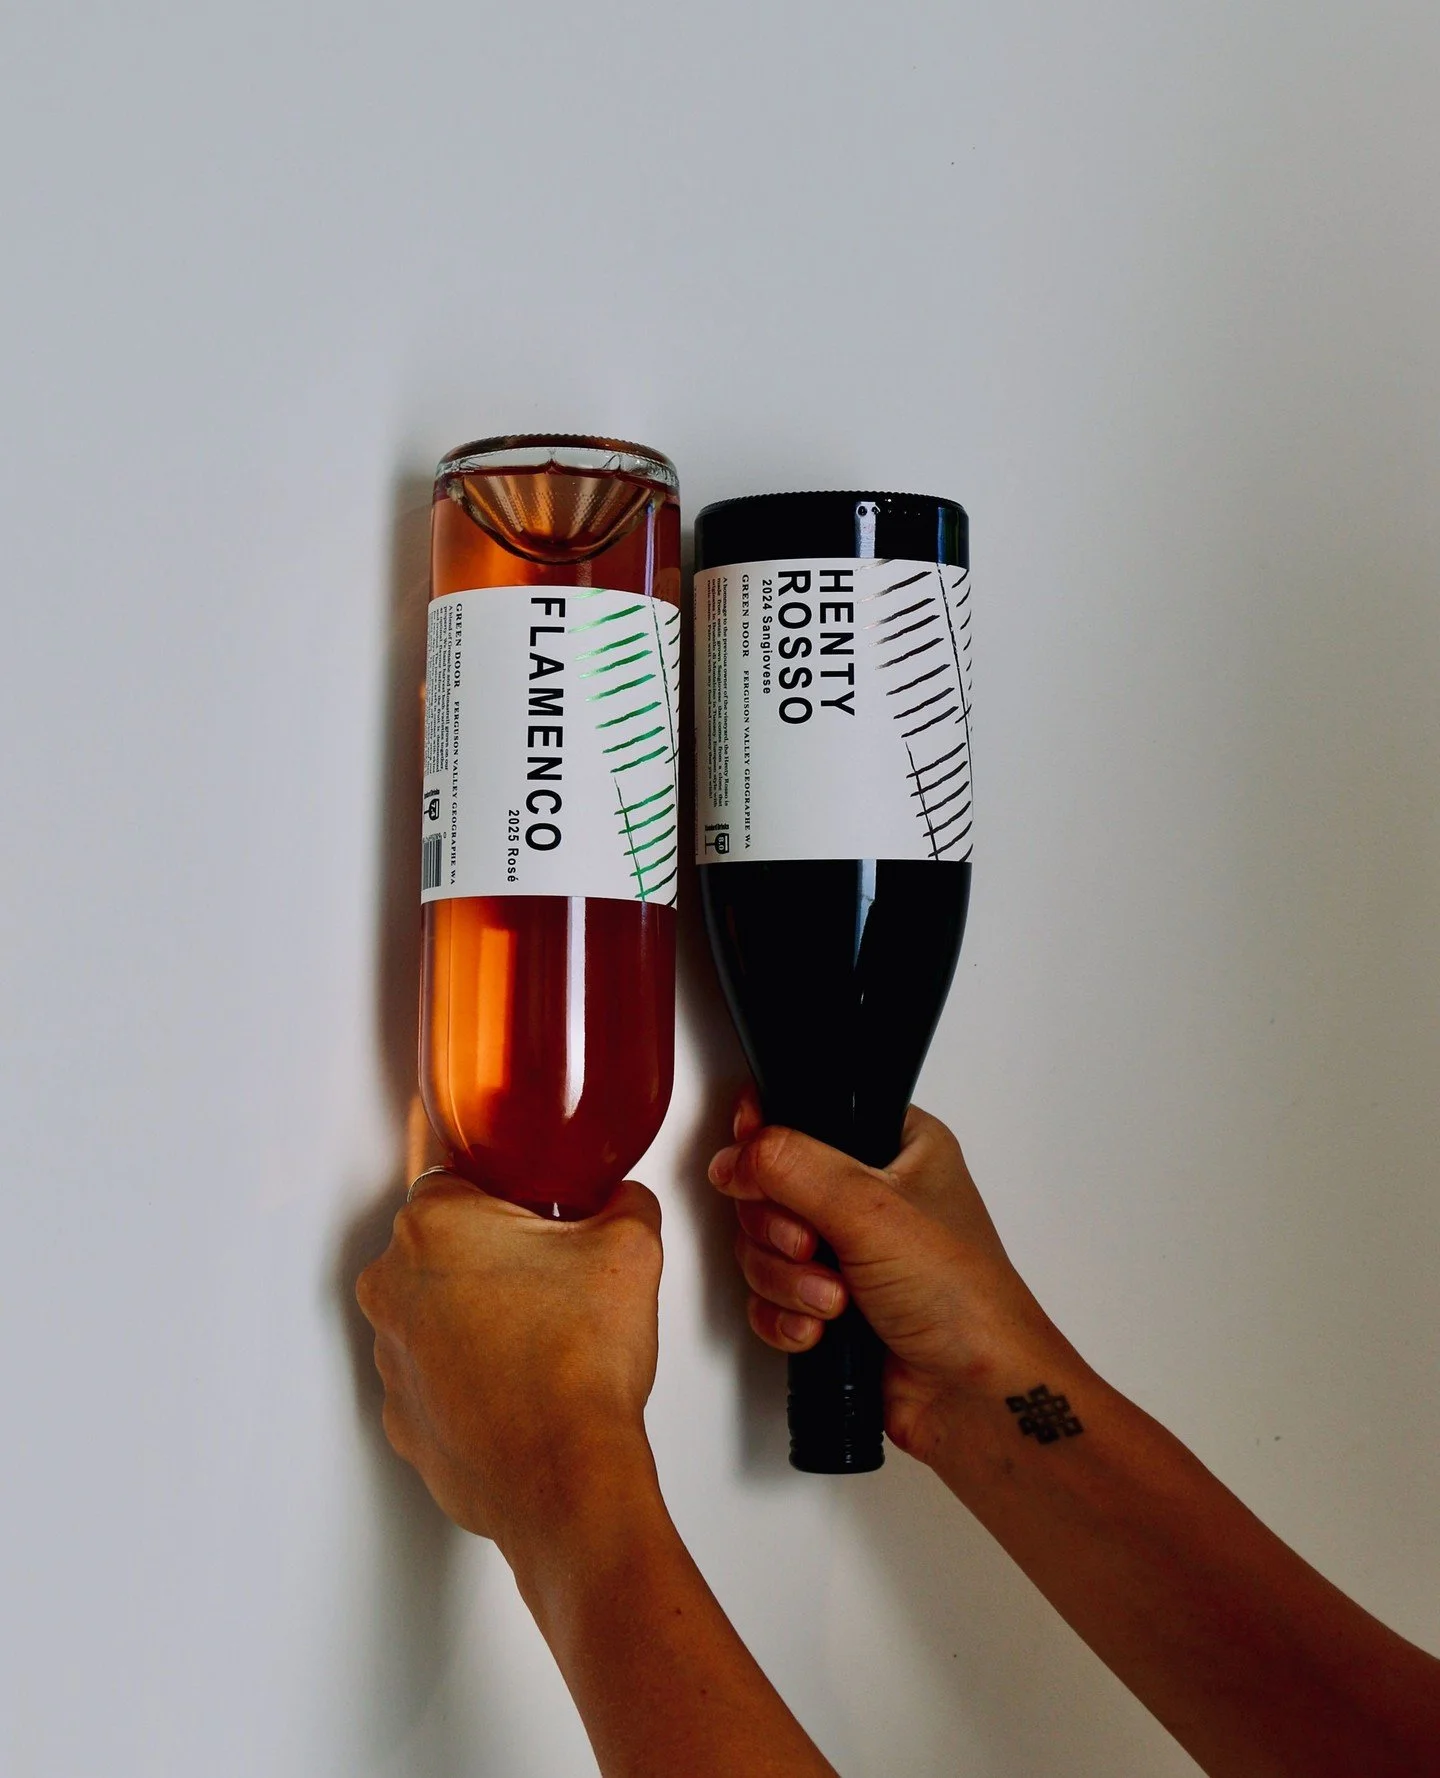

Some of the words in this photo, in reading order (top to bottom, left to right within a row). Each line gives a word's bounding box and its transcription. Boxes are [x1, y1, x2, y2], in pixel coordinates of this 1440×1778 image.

[762, 579, 772, 610] 2024
[760, 616, 773, 694] Sangiovese
[778, 570, 813, 724] ROSSO
[820, 570, 855, 716] HENTY
[525, 598, 566, 851] FLAMENCO
[508, 810, 520, 842] 2025
[745, 834, 750, 849] WA
[450, 870, 456, 885] WA
[508, 848, 520, 882] Rosé
